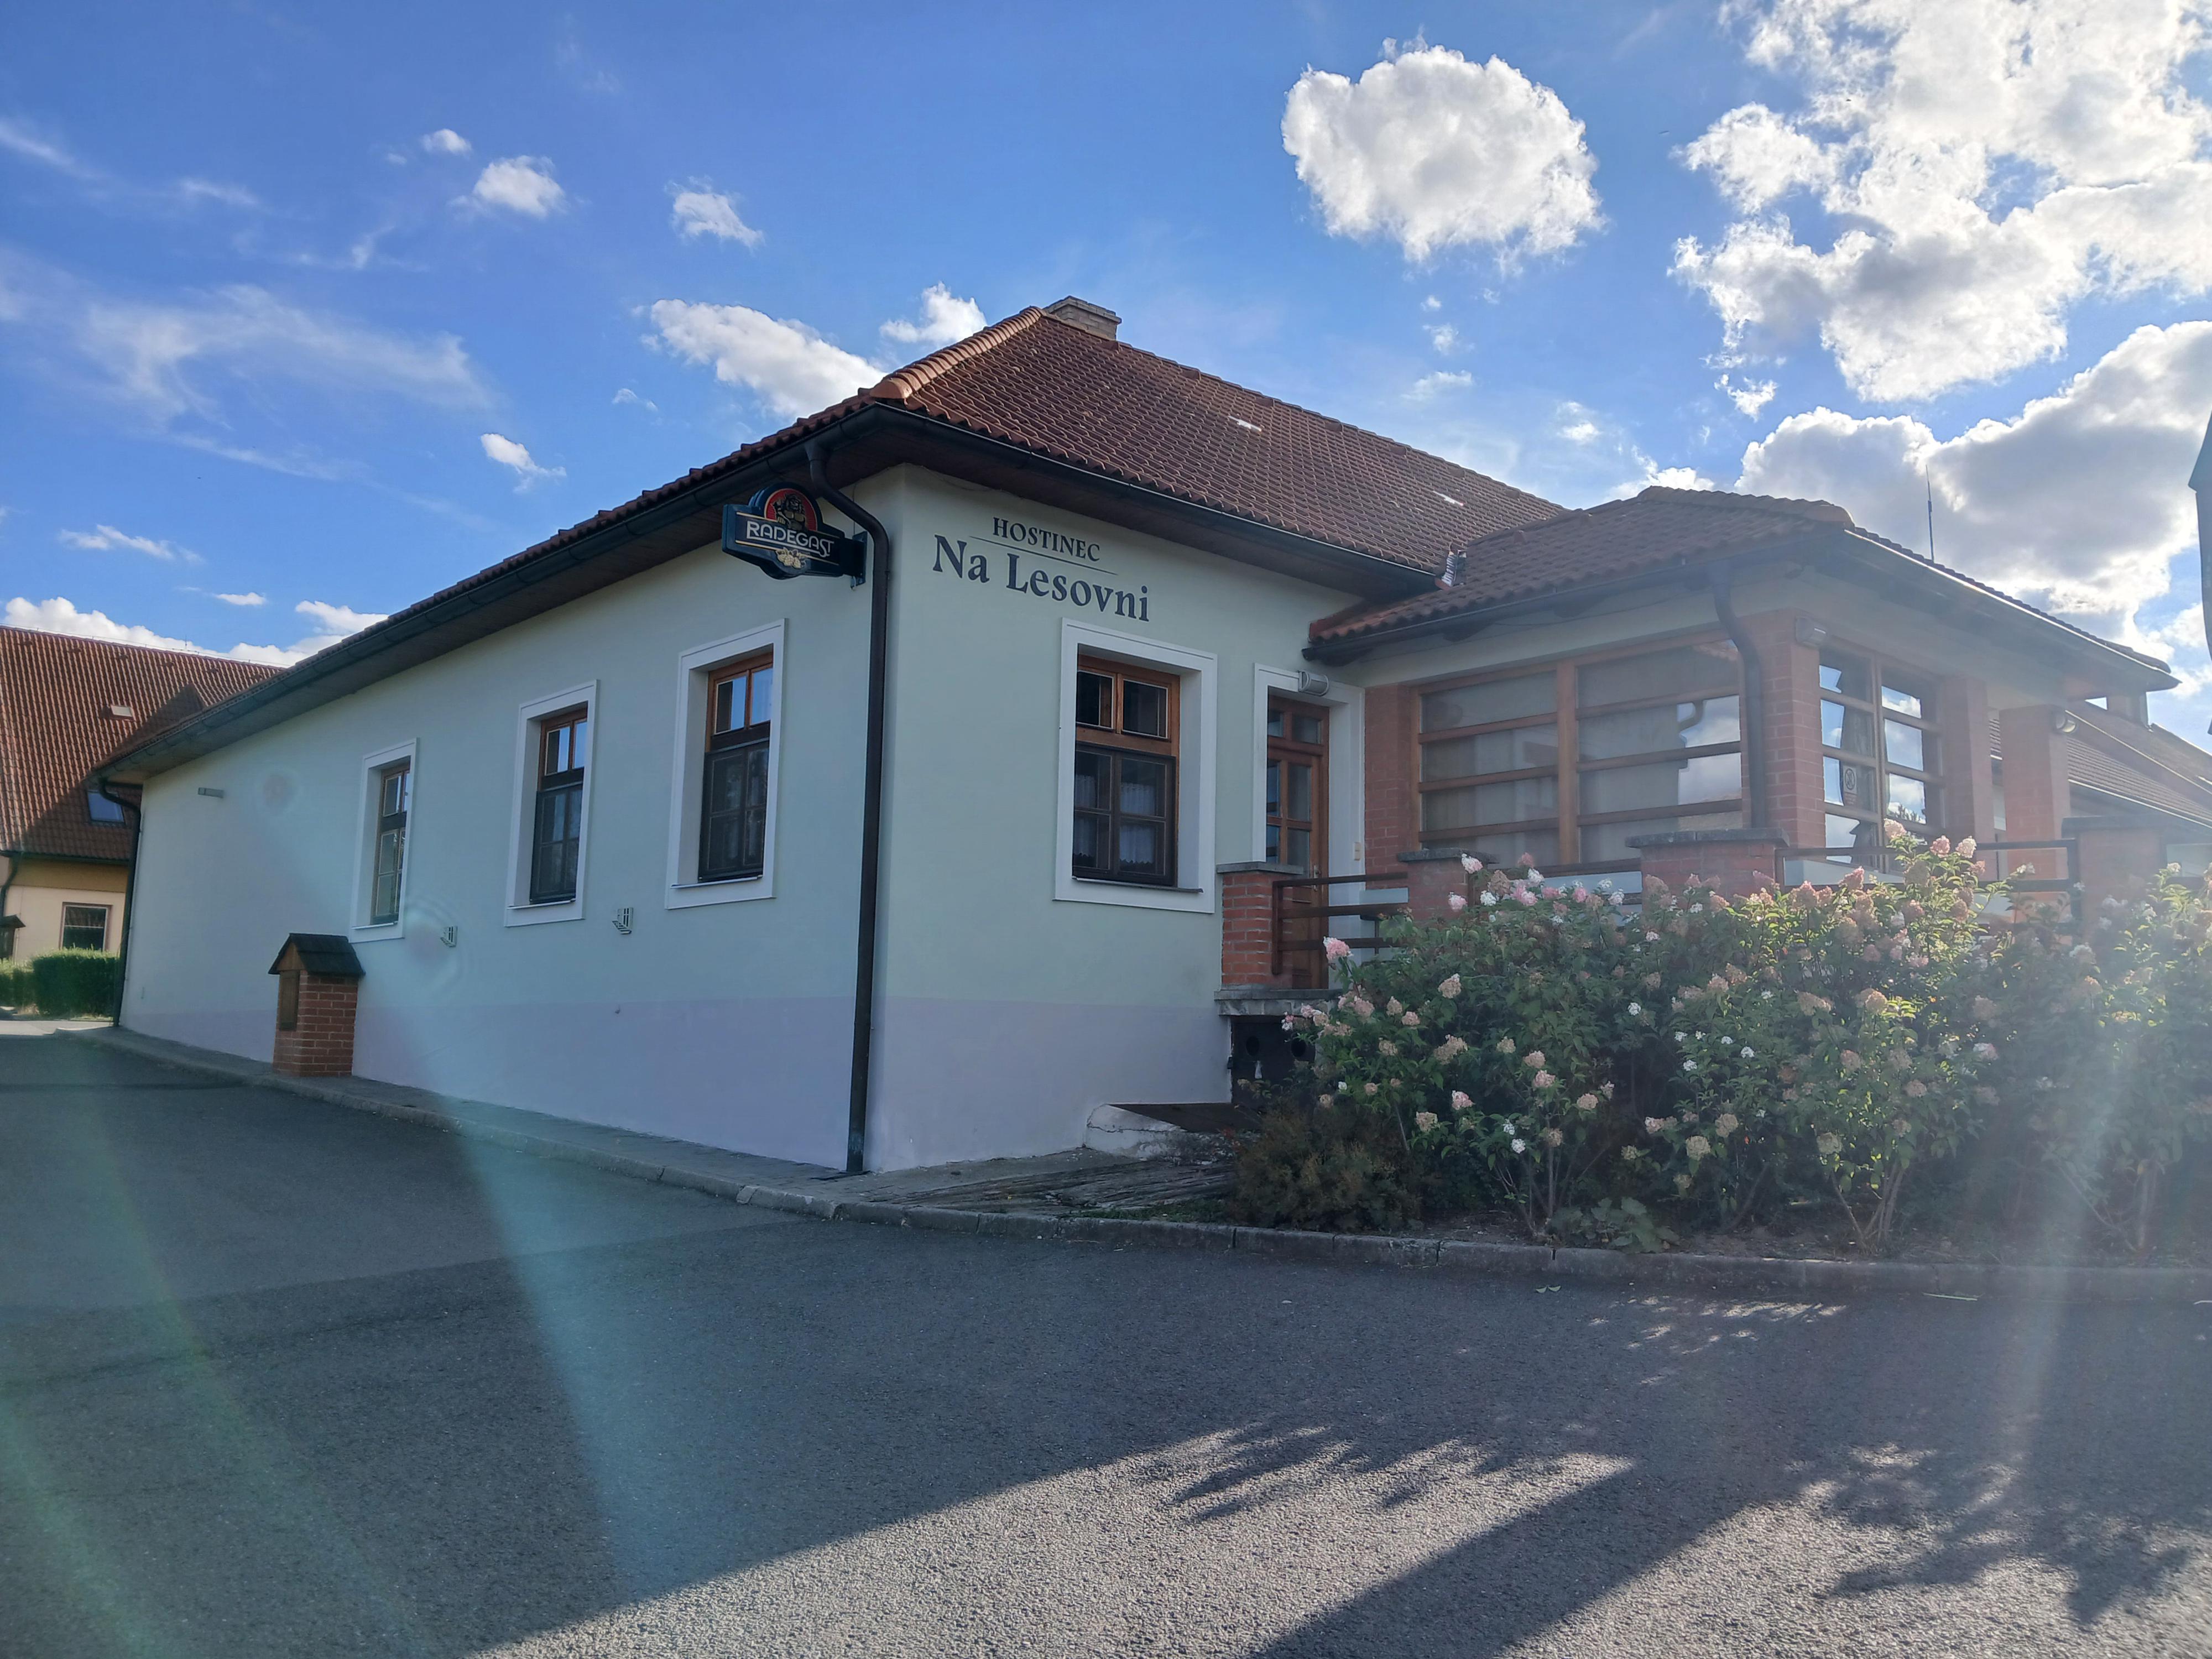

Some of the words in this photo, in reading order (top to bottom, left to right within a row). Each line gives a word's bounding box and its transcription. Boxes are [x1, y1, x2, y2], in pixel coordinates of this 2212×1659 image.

[747, 521, 834, 556] RADEGAST
[993, 517, 1100, 561] HOSTINEC
[932, 534, 989, 583] Na
[1006, 553, 1150, 622] Lesovni
